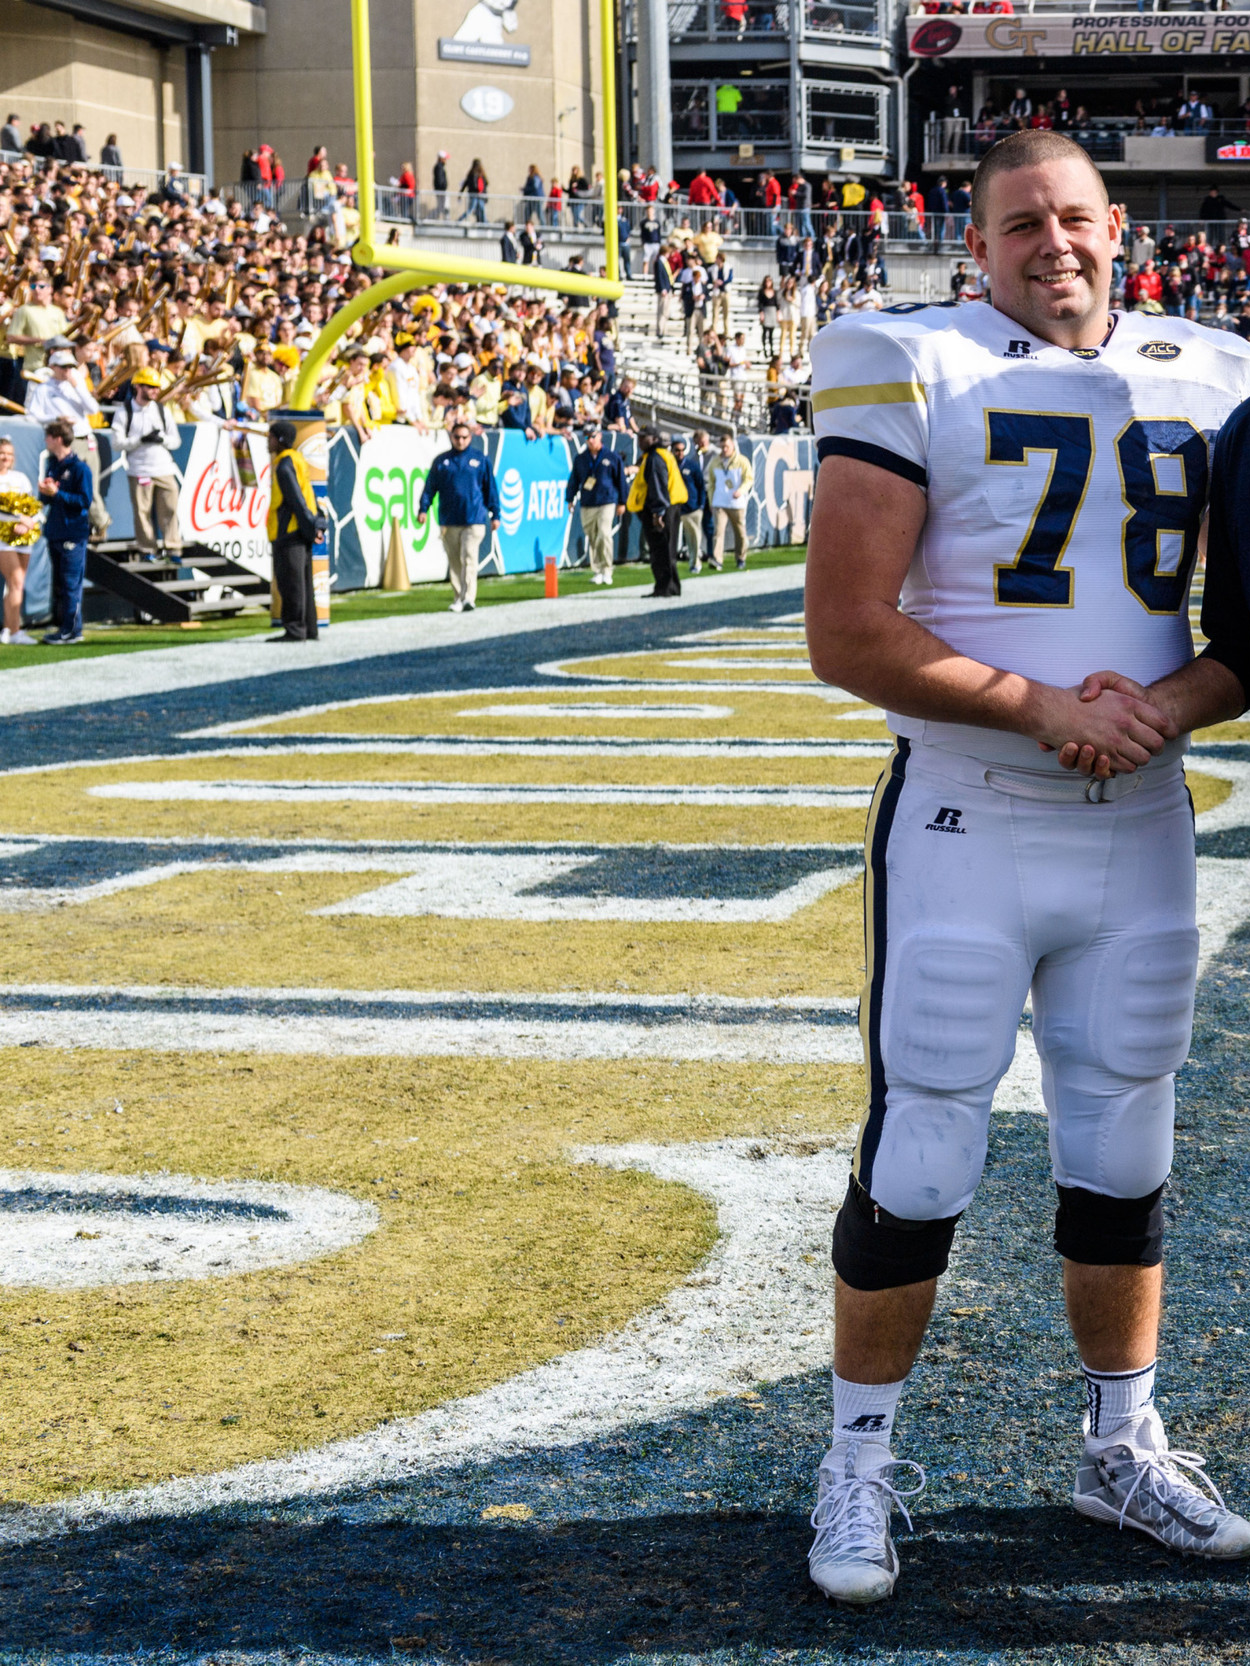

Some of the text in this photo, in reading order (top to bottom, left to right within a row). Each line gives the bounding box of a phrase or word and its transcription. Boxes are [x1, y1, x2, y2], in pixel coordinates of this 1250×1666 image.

[1072, 15, 1207, 28] PROFESSIONAL
[1072, 30, 1154, 54] HALL
[1161, 30, 1206, 53] OF
[472, 90, 504, 115] 19
[1145, 344, 1177, 354] ACC
[365, 466, 439, 552] sag
[527, 479, 568, 520] AT&T
[983, 406, 1210, 616] 78
[925, 824, 967, 834] RUSSELL
